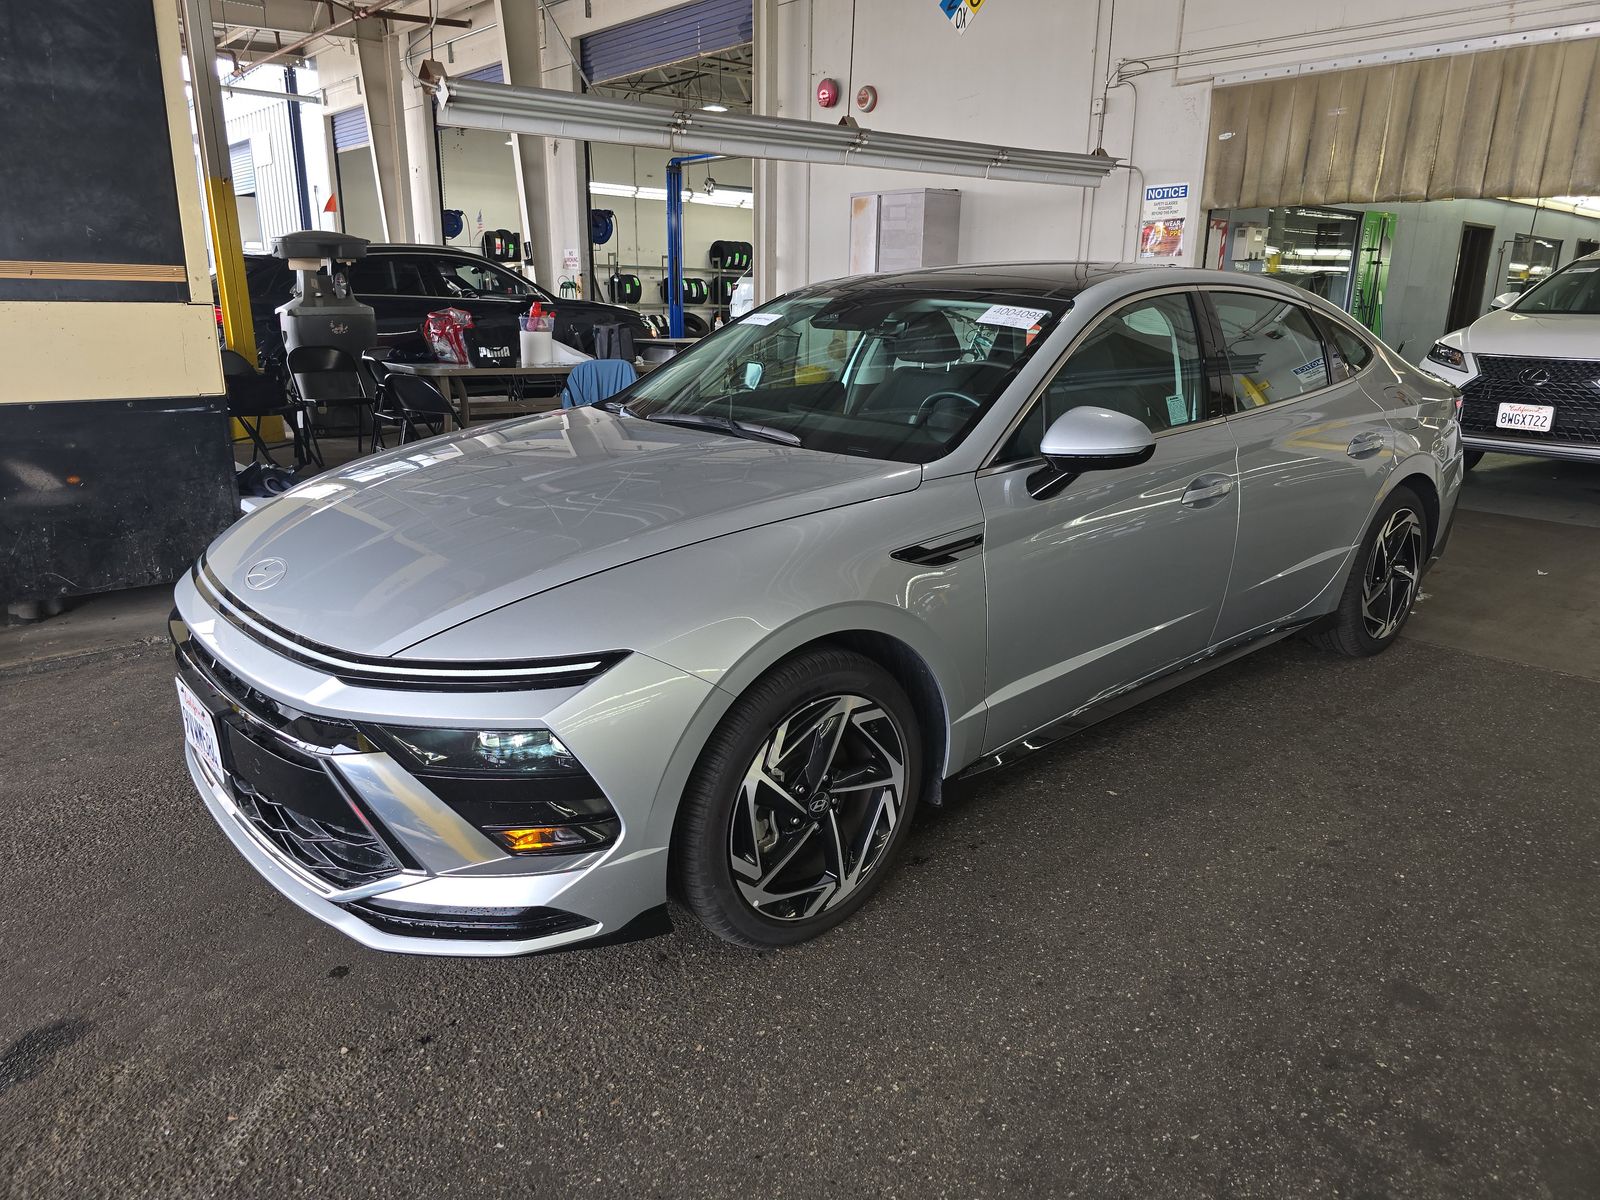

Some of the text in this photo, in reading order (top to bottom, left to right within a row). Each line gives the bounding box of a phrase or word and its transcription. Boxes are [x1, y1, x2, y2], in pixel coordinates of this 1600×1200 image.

[955, 7, 968, 29] OX
[1147, 186, 1186, 200] NOTICE
[478, 346, 511, 358] PUMA
[1500, 412, 1548, 428] 8WGX722
